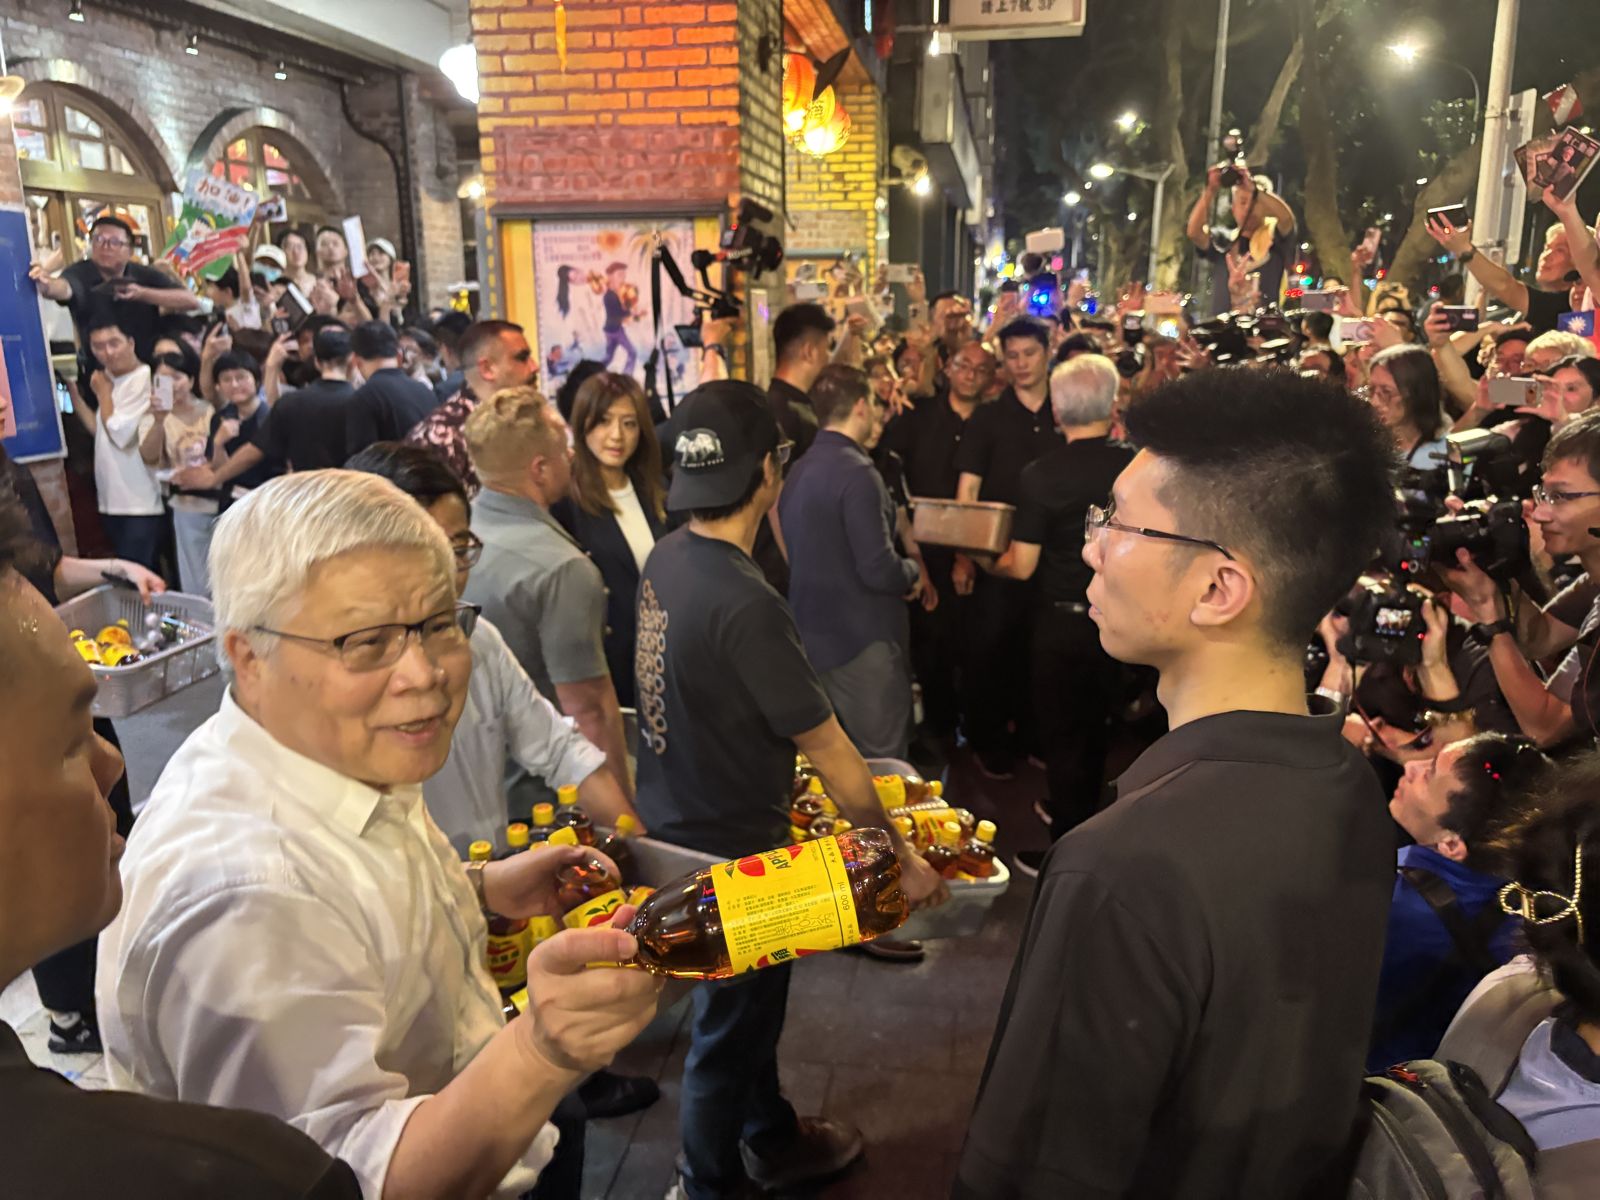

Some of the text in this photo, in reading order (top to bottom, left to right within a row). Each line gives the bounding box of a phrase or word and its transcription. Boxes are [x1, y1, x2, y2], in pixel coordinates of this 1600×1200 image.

[762, 849, 792, 870] APPL
[837, 881, 850, 911] 600 ml
